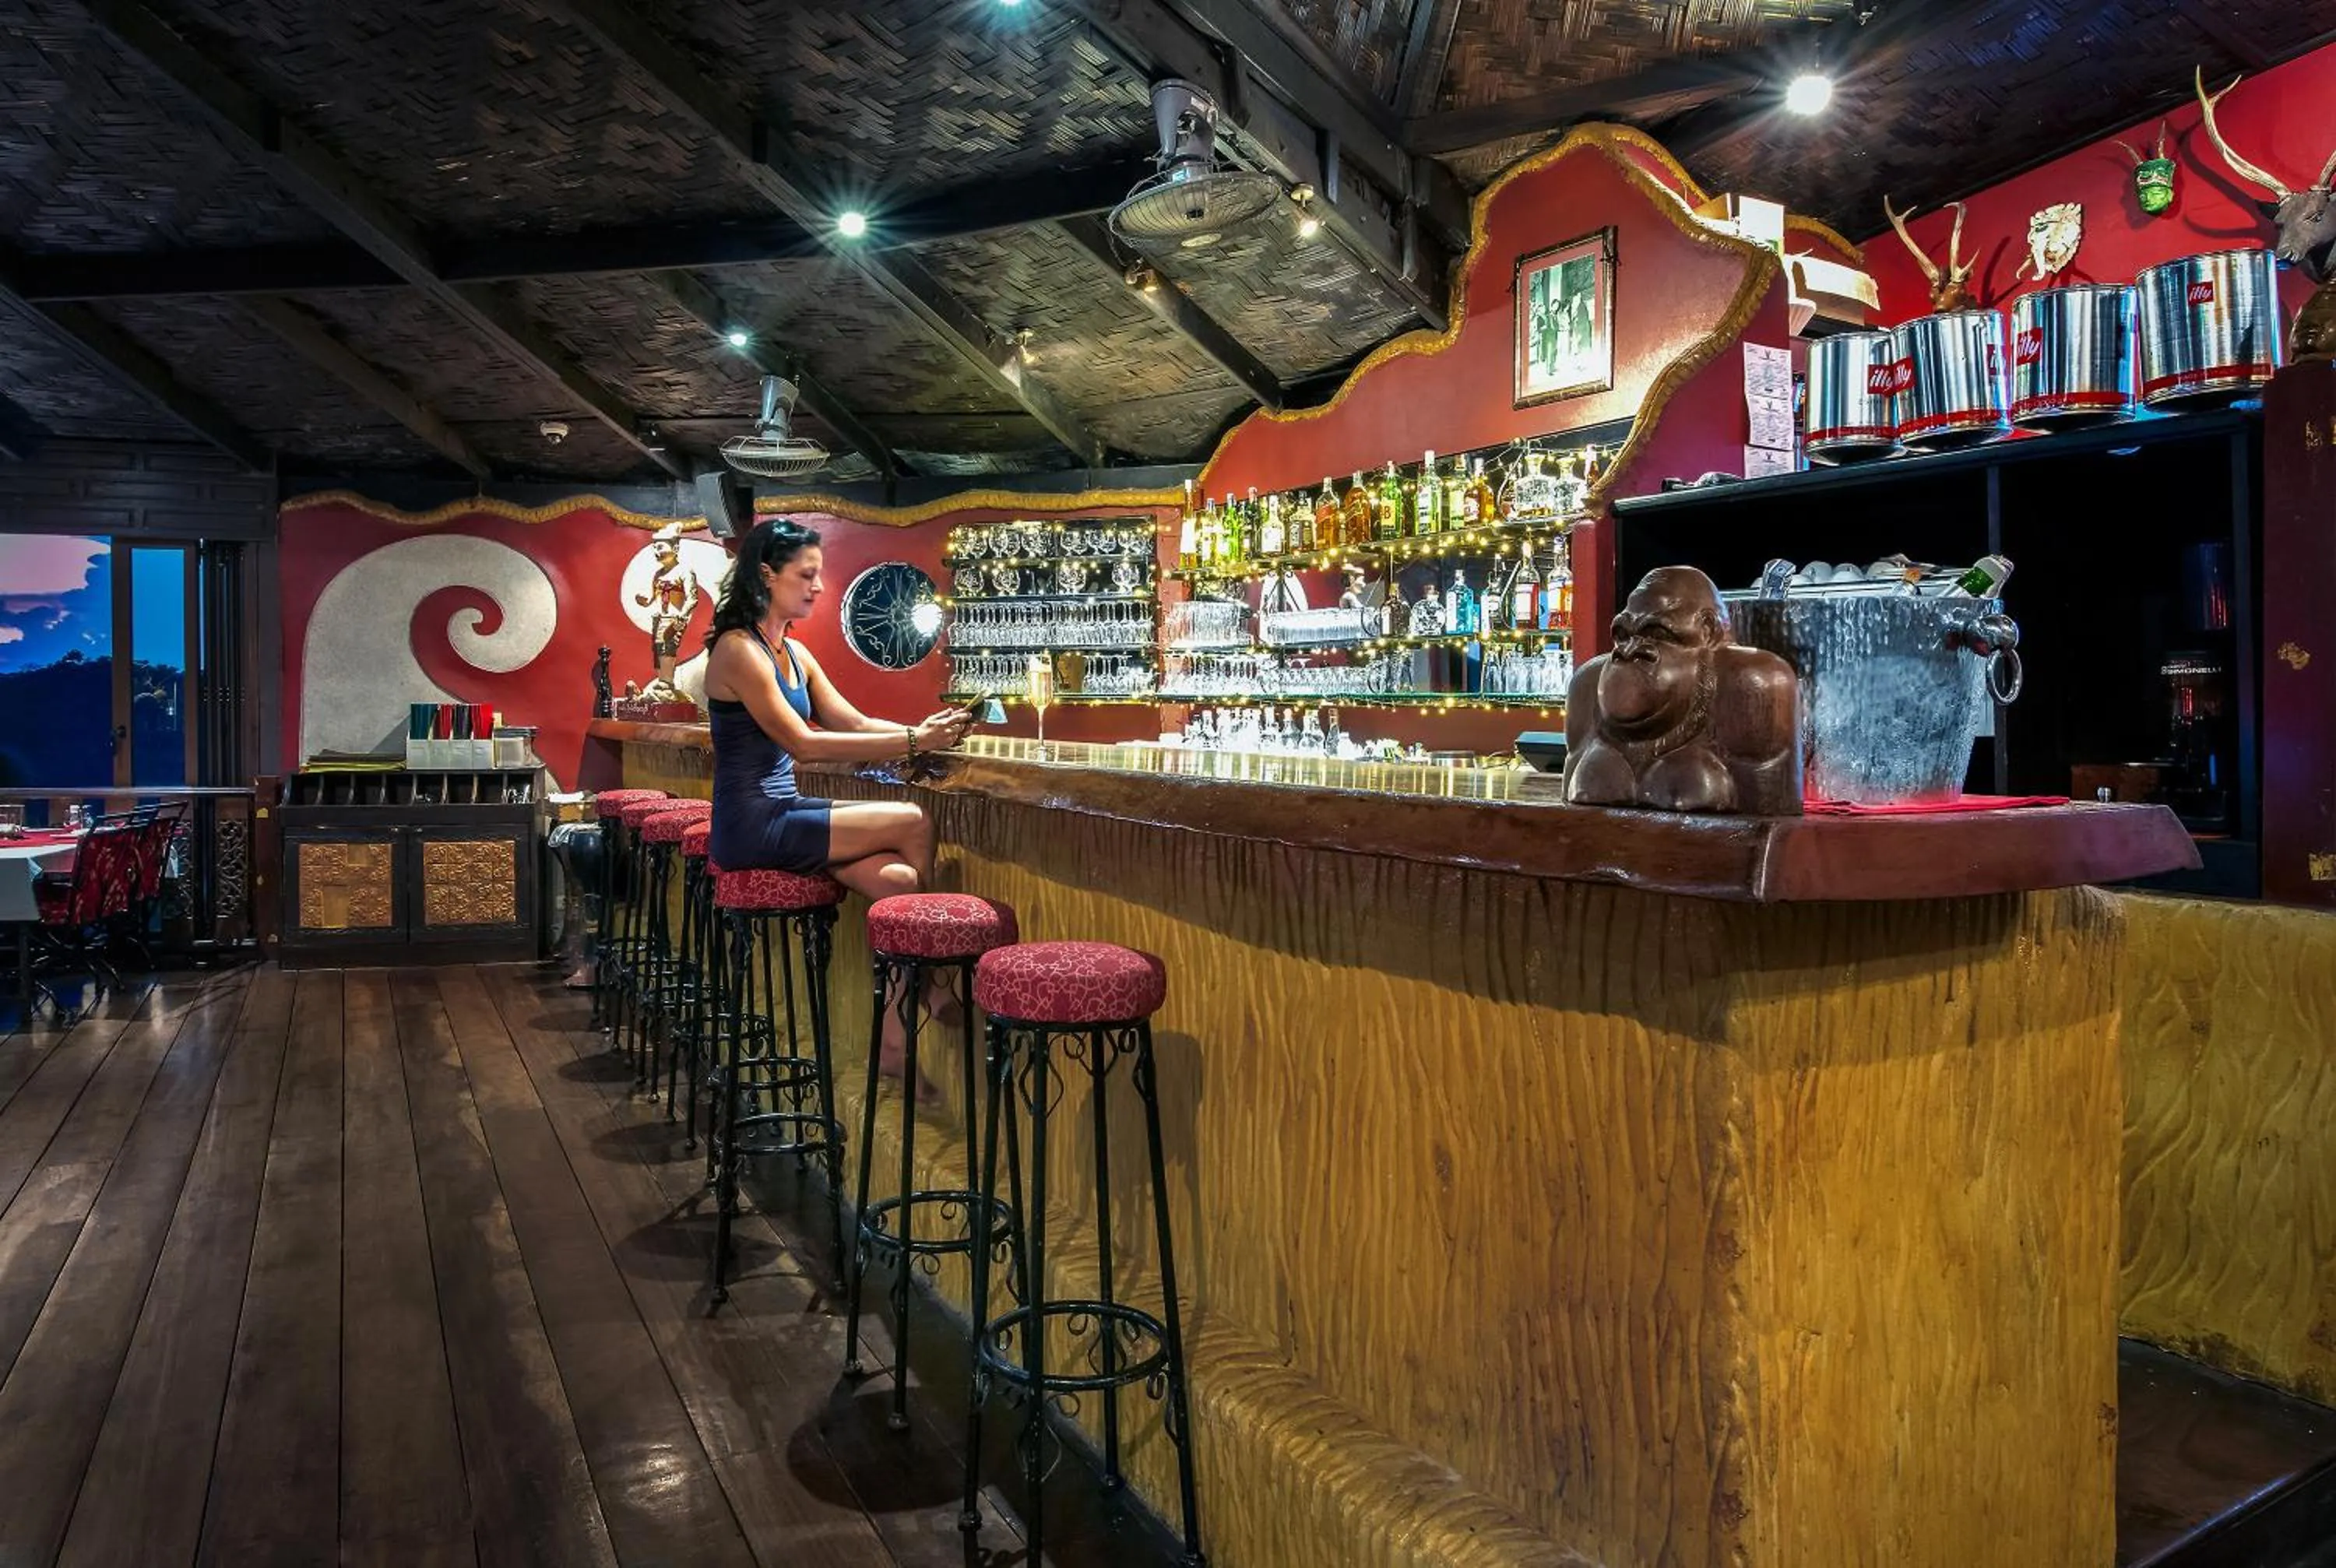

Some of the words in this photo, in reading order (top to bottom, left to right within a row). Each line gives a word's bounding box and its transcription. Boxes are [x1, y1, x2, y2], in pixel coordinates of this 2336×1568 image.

[2189, 286, 2212, 302] illy
[2018, 336, 2040, 360] illy
[1870, 368, 1893, 392] illy
